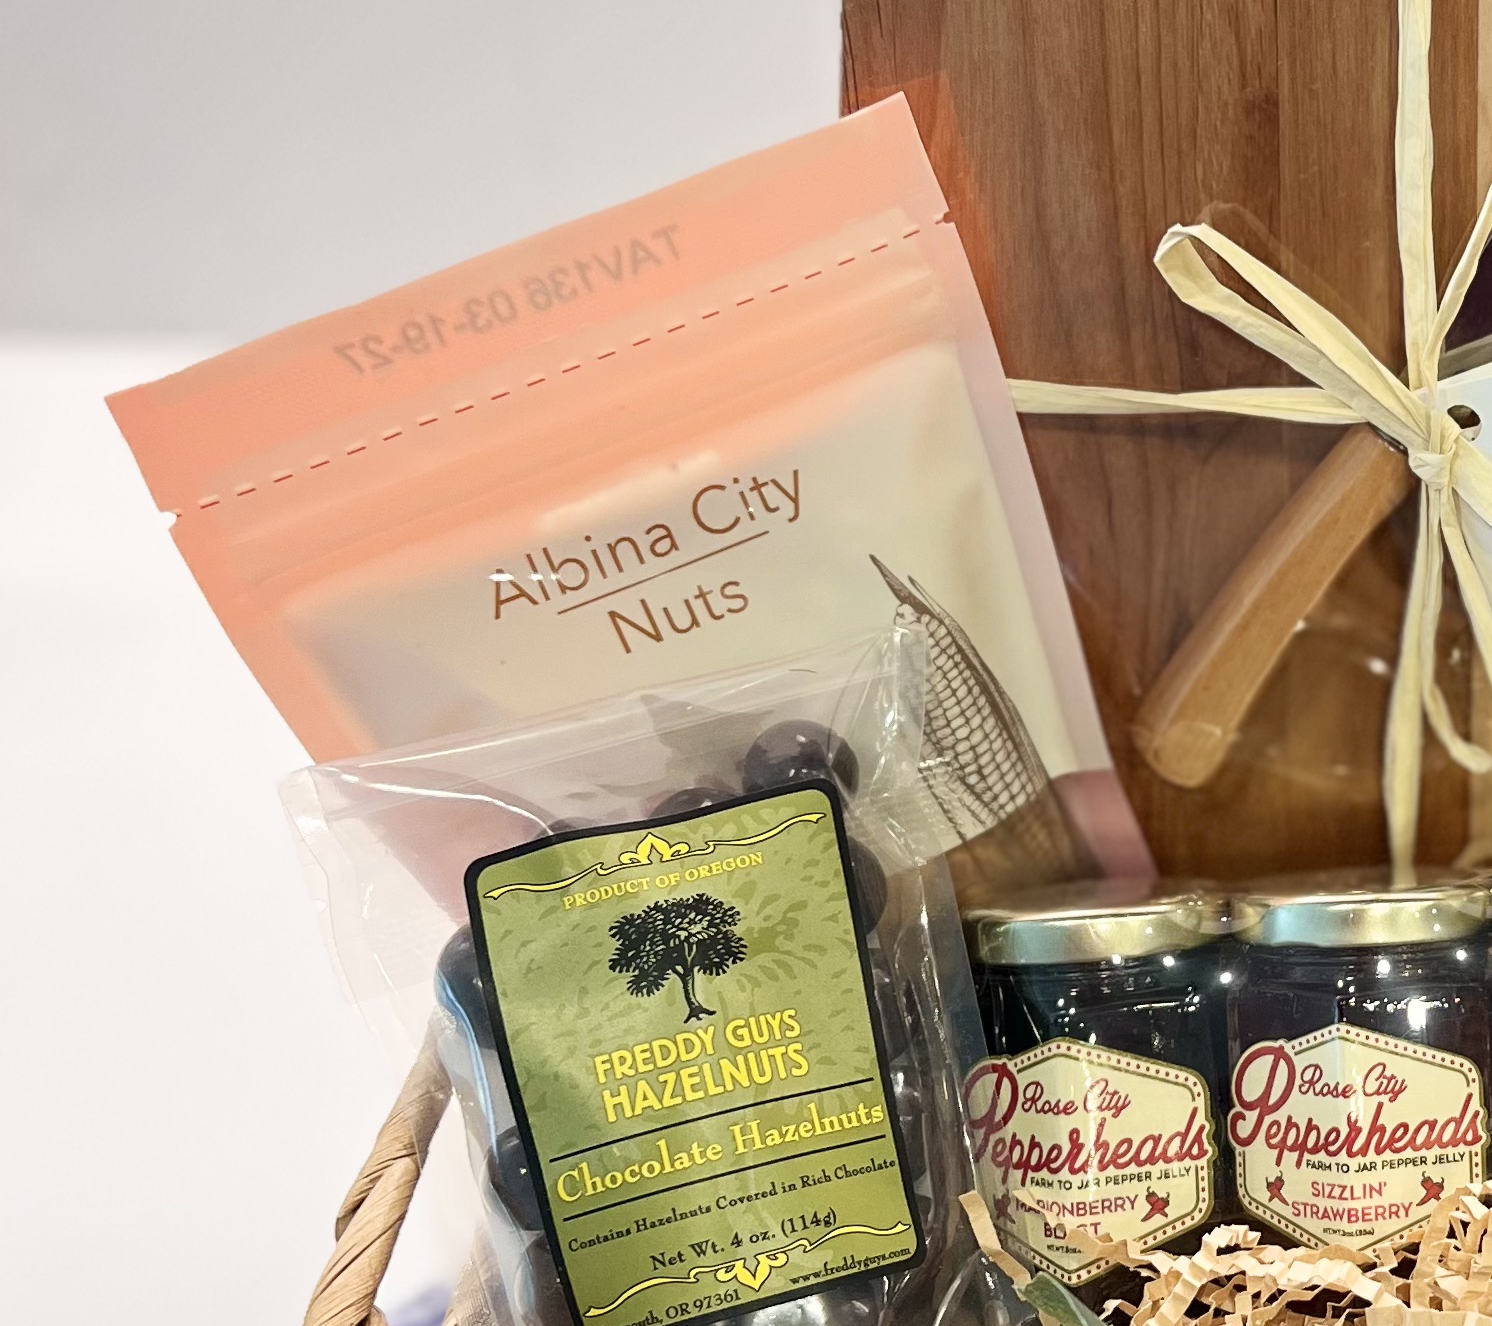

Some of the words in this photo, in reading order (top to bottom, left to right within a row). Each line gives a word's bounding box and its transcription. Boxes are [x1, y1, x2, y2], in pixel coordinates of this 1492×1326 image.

[489, 524, 680, 620] Albina
[692, 469, 799, 534] City
[608, 581, 749, 654] Nuts
[563, 878, 651, 910] PRODUCT
[656, 873, 681, 888] OF
[684, 852, 763, 882] OREGON
[594, 1026, 715, 1084] FREDDY
[725, 1010, 801, 1048] GUYS
[602, 1043, 809, 1123] HAZELNUTS
[1022, 1081, 1078, 1115] Rose
[1083, 1078, 1131, 1118] City
[1230, 1045, 1483, 1169] Pepperheads
[1299, 1064, 1355, 1098] Rose
[1362, 1062, 1408, 1102] City
[557, 1139, 723, 1203] Chocolate
[729, 1102, 885, 1156] Hazelnuts
[964, 1062, 1208, 1187] Pepperheads
[1031, 1176, 1054, 1189] FARM
[1057, 1179, 1073, 1190] TO
[1105, 1170, 1152, 1186] PEPPER
[1156, 1166, 1192, 1180] JELLY
[1306, 1159, 1332, 1171] FARM
[1335, 1161, 1350, 1173] TO
[1354, 1159, 1377, 1172] JAR
[1382, 1155, 1428, 1170] PEPPER
[1432, 1152, 1466, 1165] JELLY
[1311, 1181, 1387, 1201] SIZZLIN'
[568, 1227, 632, 1252] Contains
[634, 1204, 712, 1234] Hazelnuts
[716, 1182, 778, 1210] Covered
[781, 1182, 798, 1193] in
[800, 1170, 832, 1189] Rich
[834, 1158, 896, 1180] Chocolate
[1292, 1201, 1413, 1224] STRAWBERRY
[650, 1252, 686, 1271] Net
[689, 1239, 725, 1260] Wt.
[730, 1232, 743, 1248] 4
[749, 1229, 776, 1244] oz.
[781, 1207, 837, 1238] (114g)
[789, 1247, 911, 1285] www.freddyguys.com
[666, 1302, 691, 1320] OR
[694, 1289, 742, 1312] 97361
